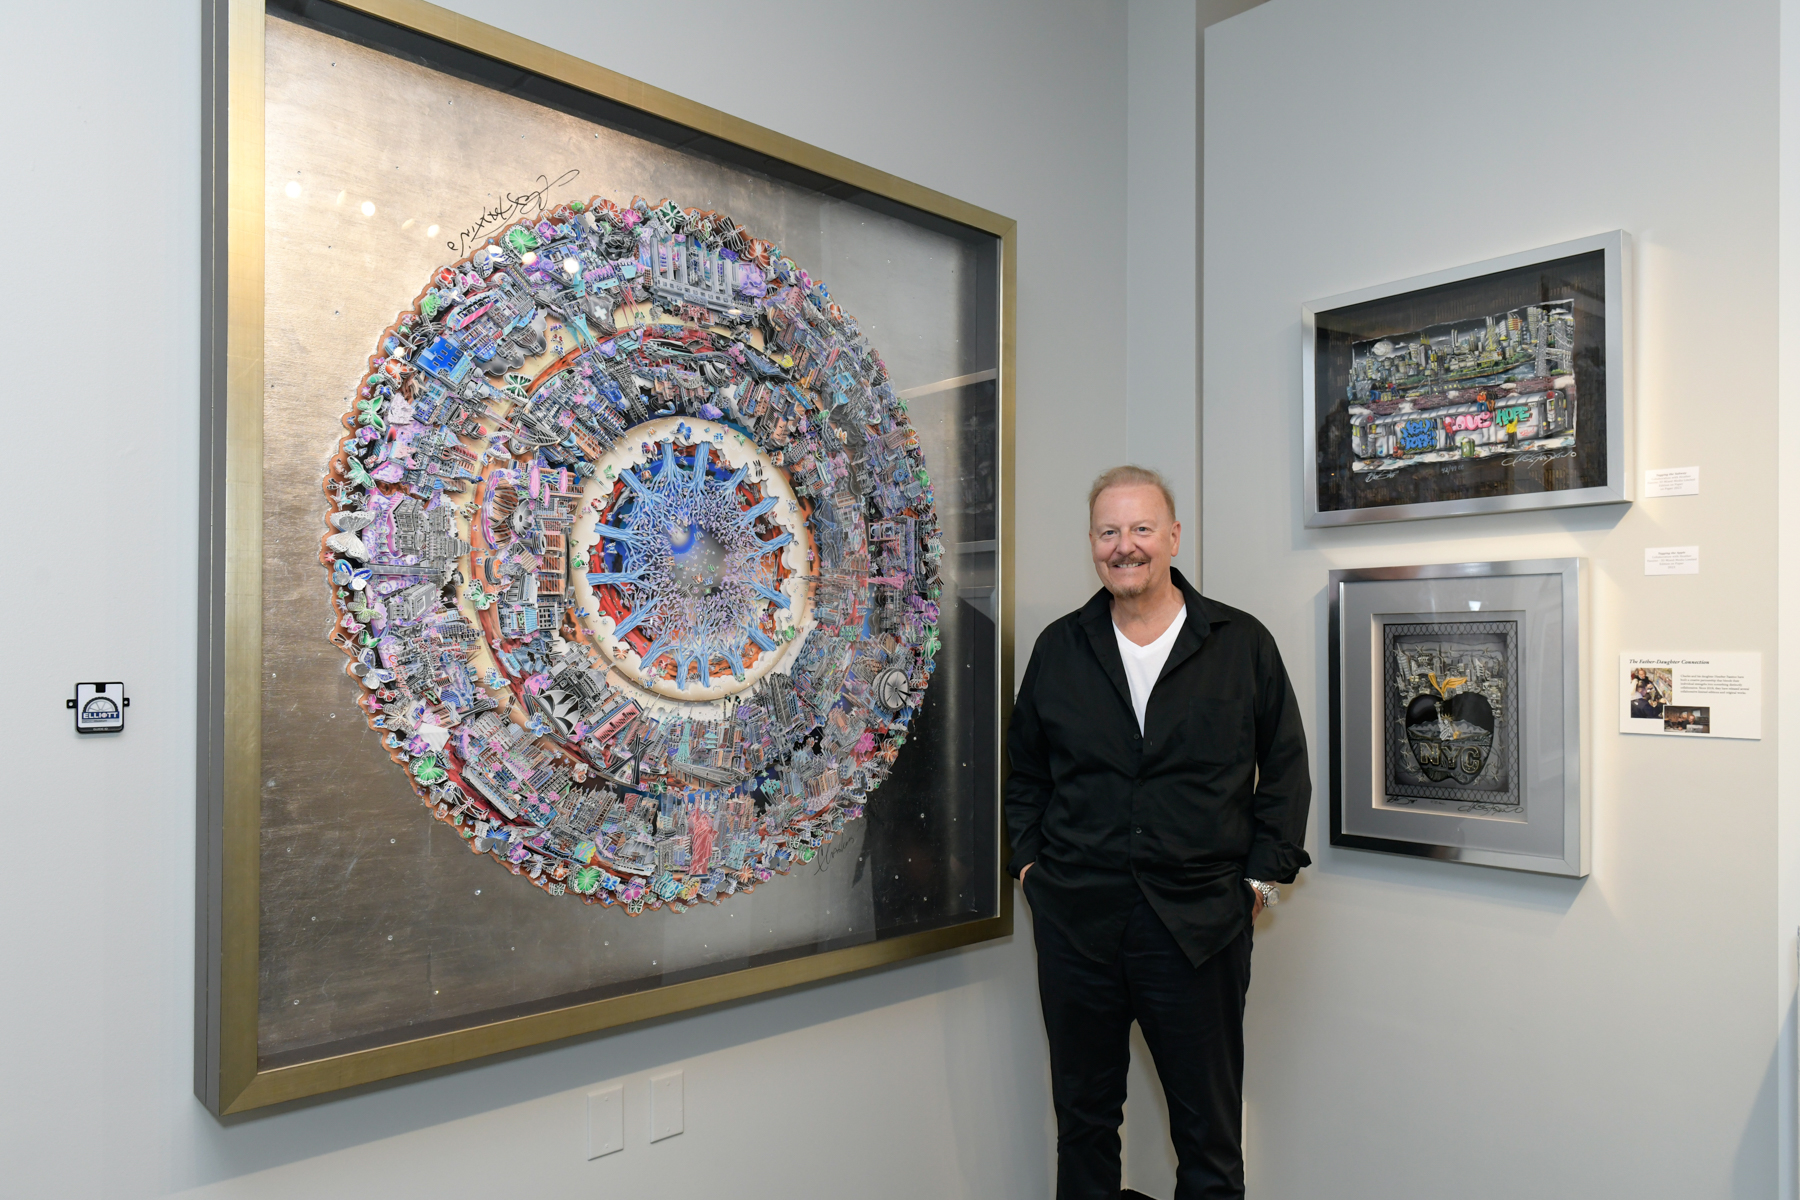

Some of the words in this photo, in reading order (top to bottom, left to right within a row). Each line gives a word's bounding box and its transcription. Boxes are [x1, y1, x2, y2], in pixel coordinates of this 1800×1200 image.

[1445, 411, 1492, 431] LOVE
[1496, 405, 1530, 427] HOPE
[1639, 658, 1680, 666] Father-Daughter
[1420, 742, 1480, 774] NYC
